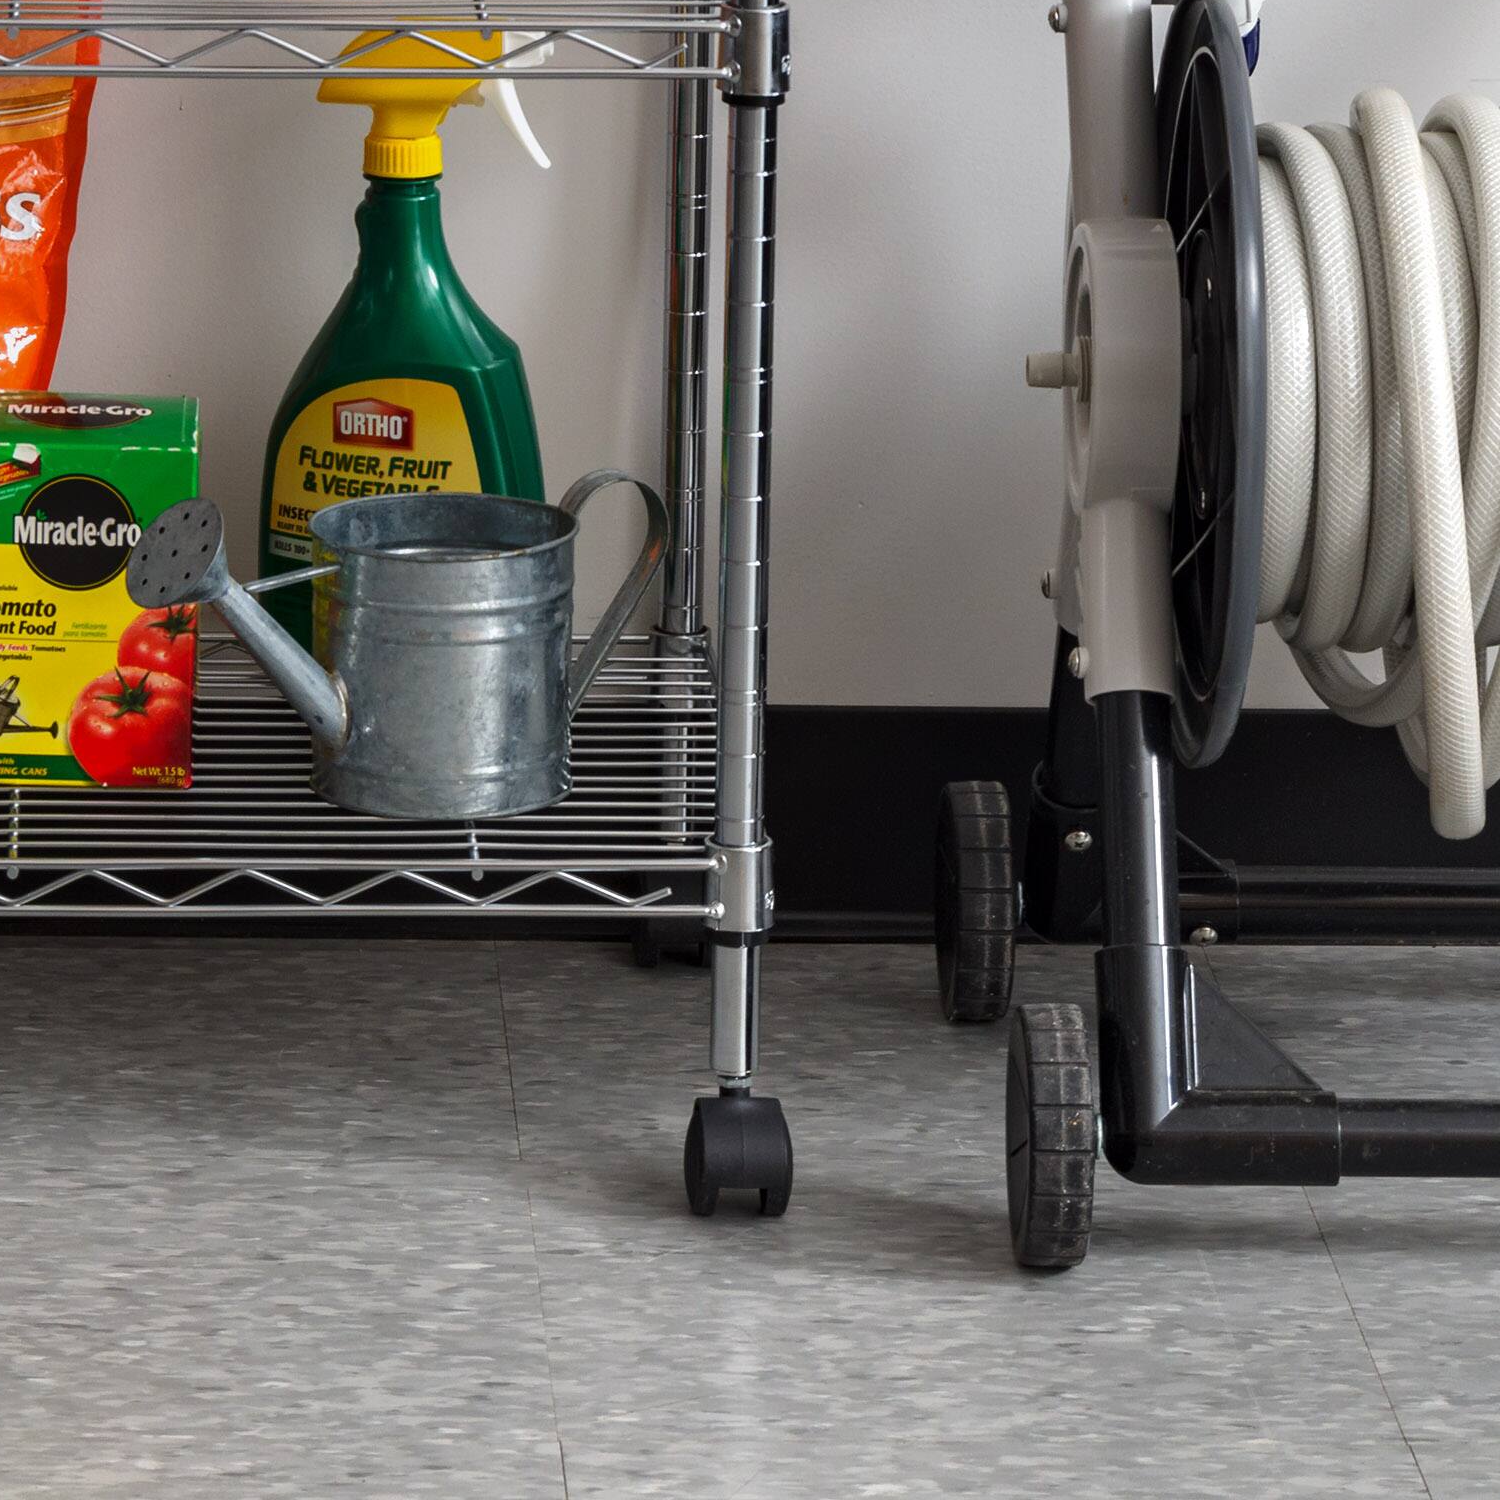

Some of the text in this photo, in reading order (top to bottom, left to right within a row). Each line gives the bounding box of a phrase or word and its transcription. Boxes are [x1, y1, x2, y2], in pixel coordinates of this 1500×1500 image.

[340, 409, 403, 440] ORTHO
[299, 445, 453, 481] FLOWER, FRUIT
[303, 470, 318, 493] &
[278, 504, 317, 522] INSEC
[18, 620, 57, 636] Food
[7, 643, 29, 652] Feeds
[31, 644, 67, 653] Tomatoes
[20, 766, 49, 776] CANS
[132, 766, 147, 776] Net
